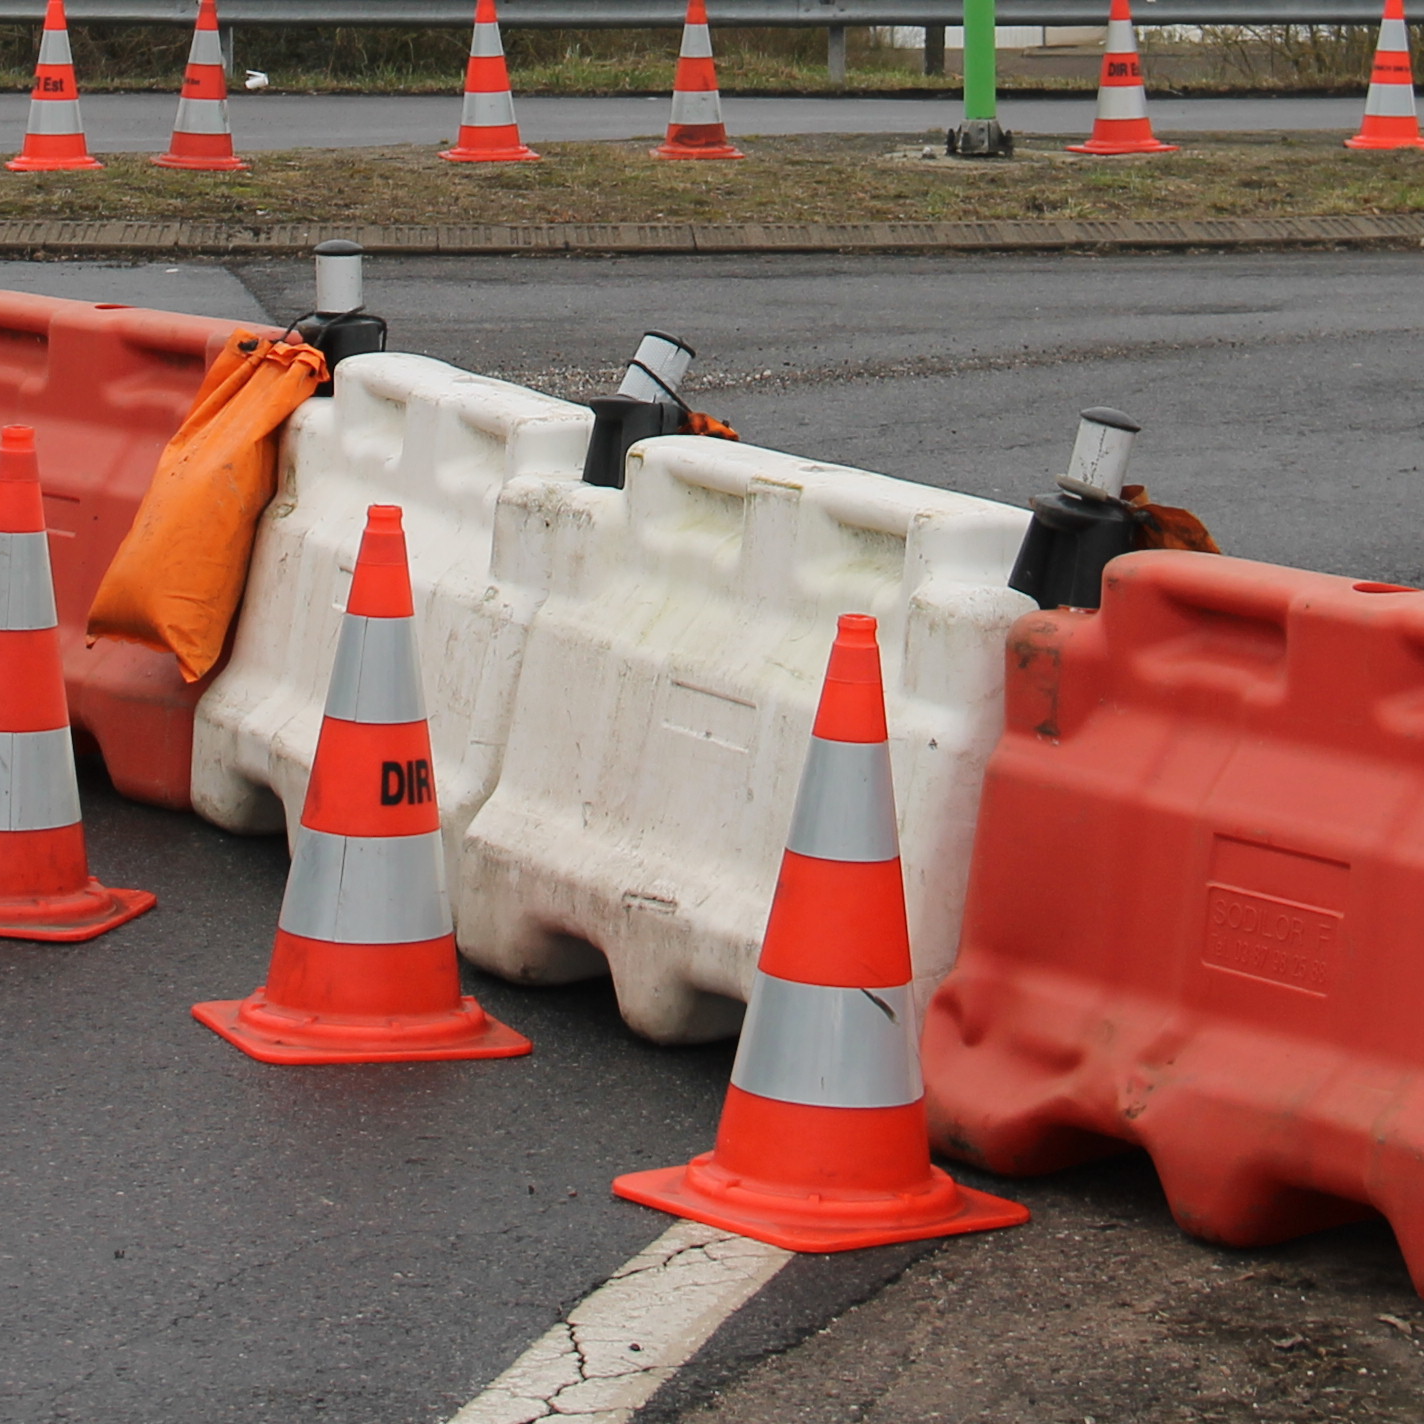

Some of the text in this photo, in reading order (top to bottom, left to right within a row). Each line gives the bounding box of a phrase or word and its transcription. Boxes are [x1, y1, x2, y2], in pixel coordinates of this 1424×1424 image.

[43, 76, 64, 92] Est
[381, 759, 432, 806] DIR
[1213, 898, 1305, 946] SODILOR
